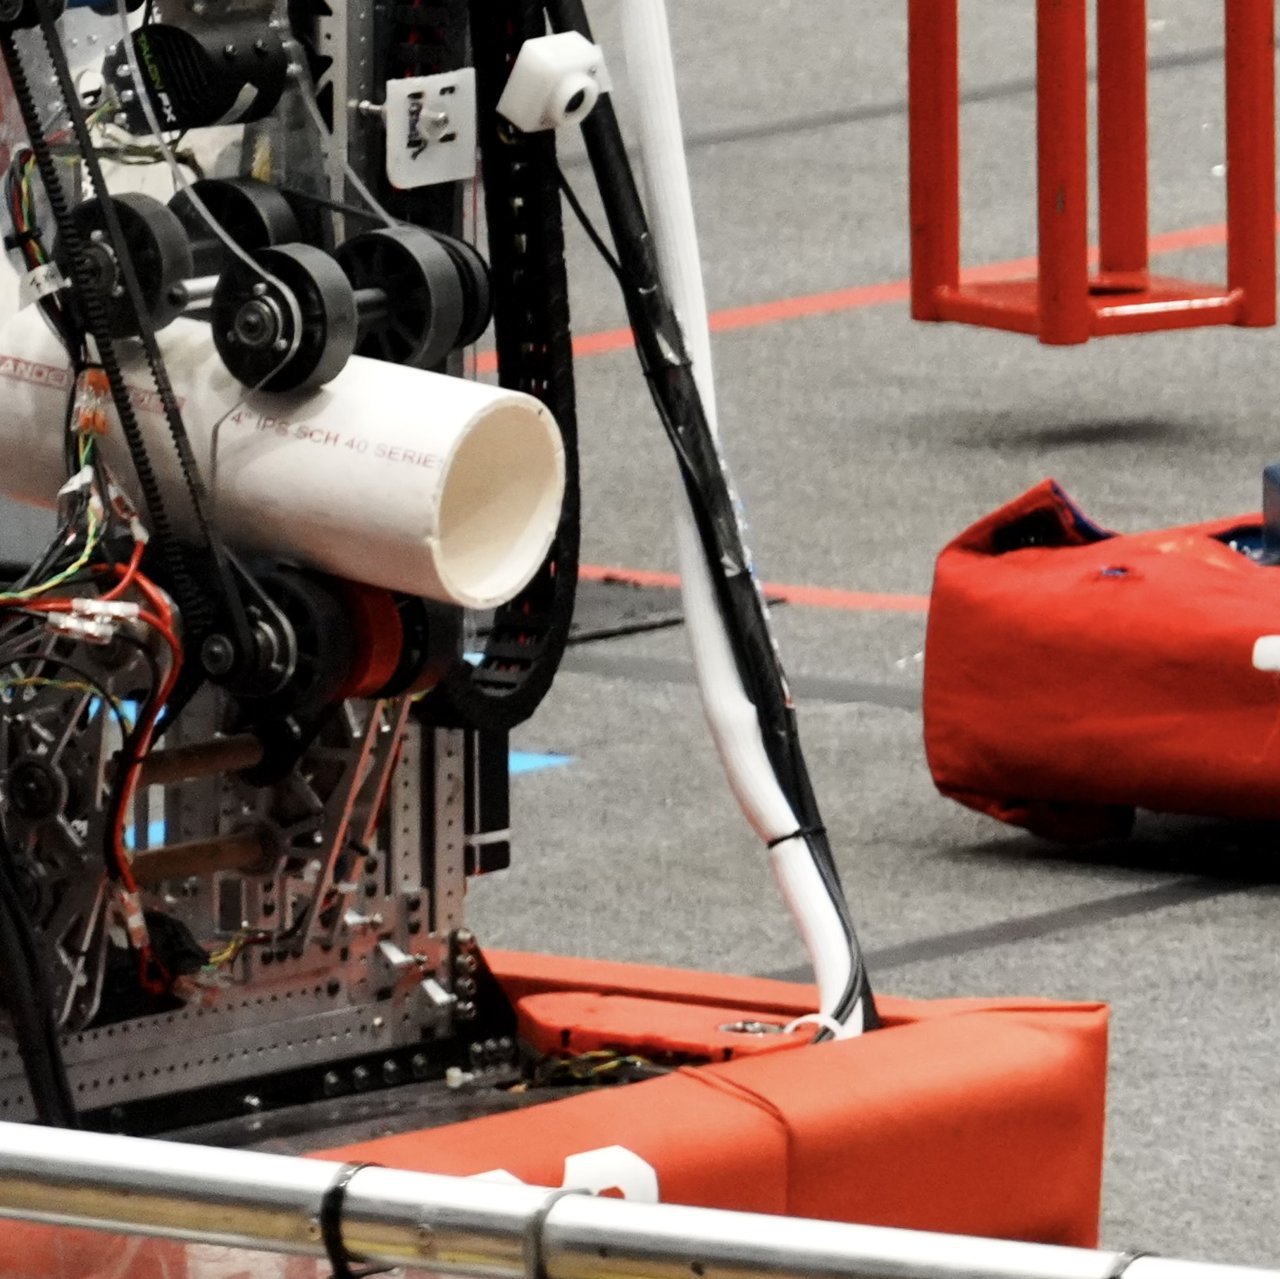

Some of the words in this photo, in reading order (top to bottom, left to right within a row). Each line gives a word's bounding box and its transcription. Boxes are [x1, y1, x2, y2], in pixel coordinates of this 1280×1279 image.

[157, 91, 178, 123] FX
[256, 416, 290, 436] IPS
[295, 424, 341, 447] SCH
[344, 436, 369, 455] 40
